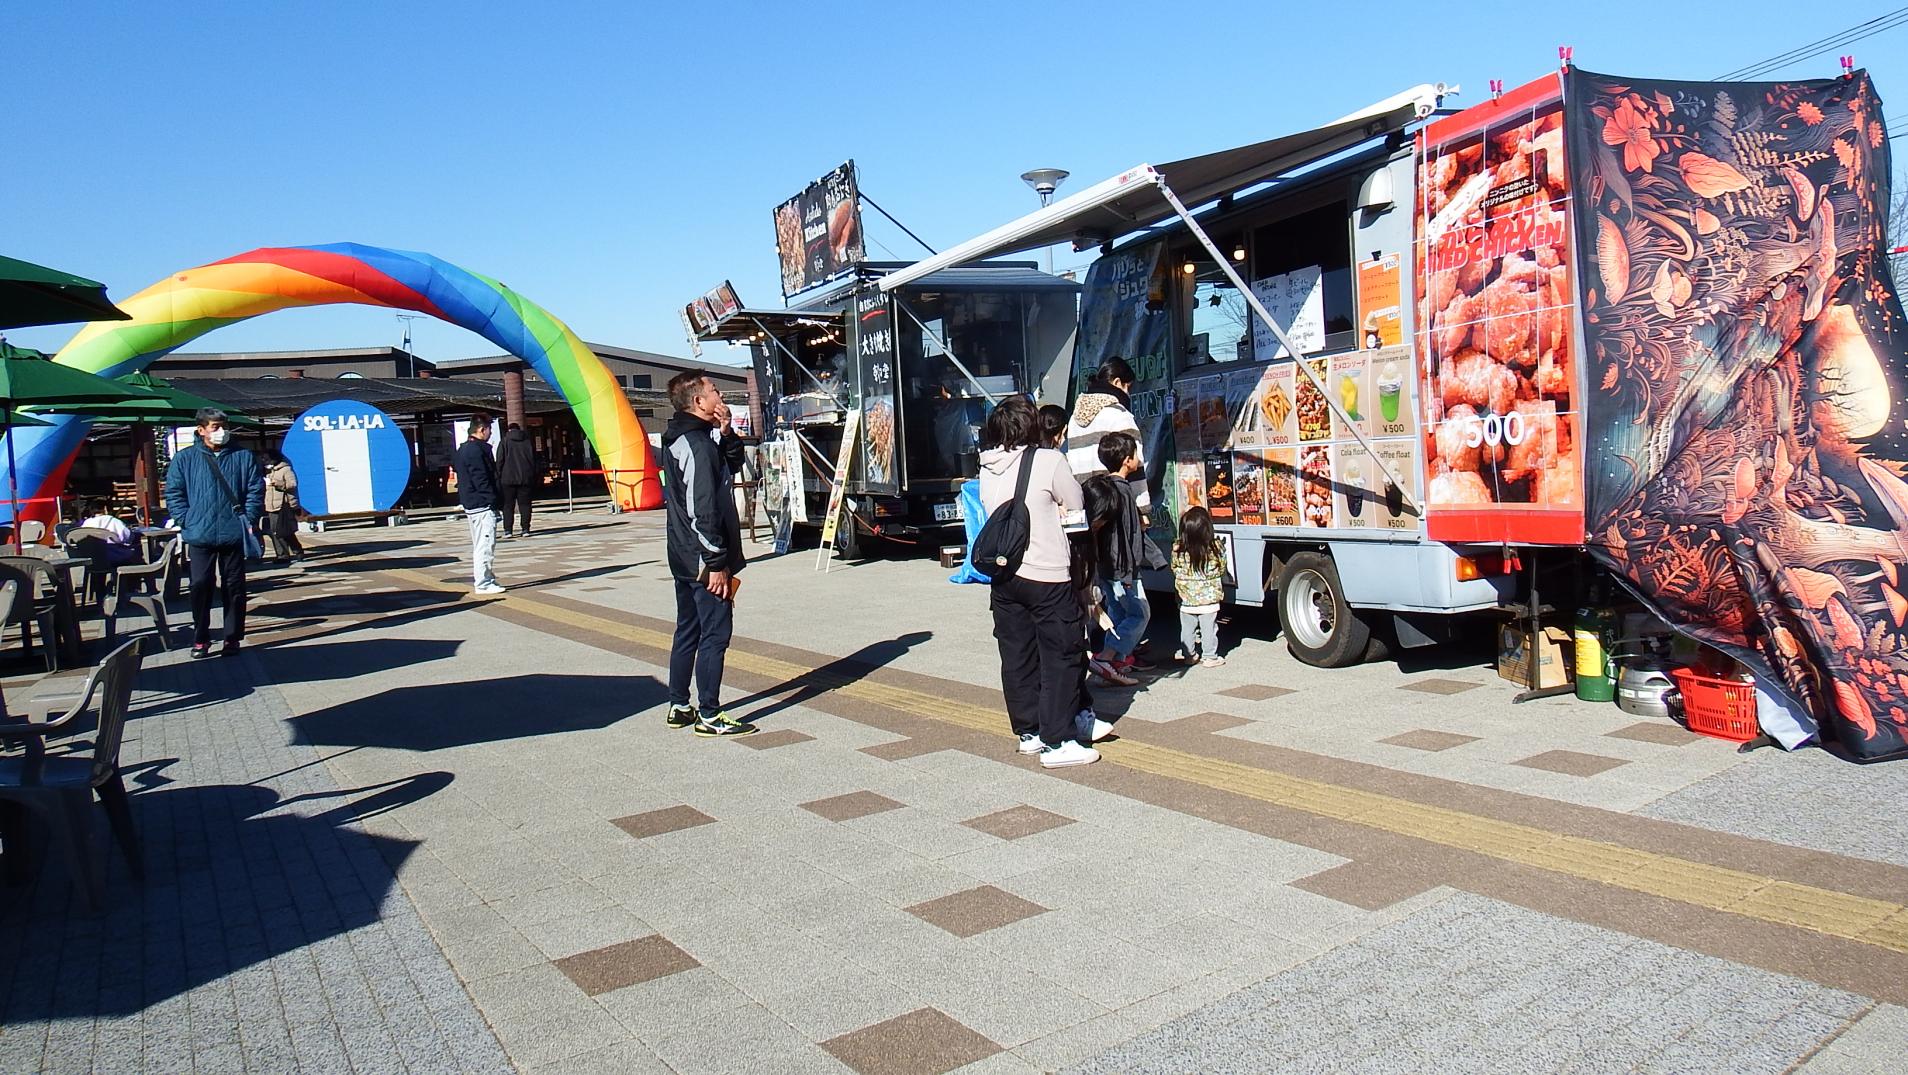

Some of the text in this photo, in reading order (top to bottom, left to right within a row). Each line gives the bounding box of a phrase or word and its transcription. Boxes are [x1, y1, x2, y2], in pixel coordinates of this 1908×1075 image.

[1468, 220, 1564, 263] CHICKEN
[1383, 424, 1405, 433] ¥500
[1239, 435, 1255, 444] ¥400
[1340, 448, 1367, 457] Cola float
[1376, 450, 1411, 458] offee float
[1276, 515, 1294, 526] ¥600
[1349, 519, 1365, 527] ¥500
[1388, 519, 1406, 528] ¥500
